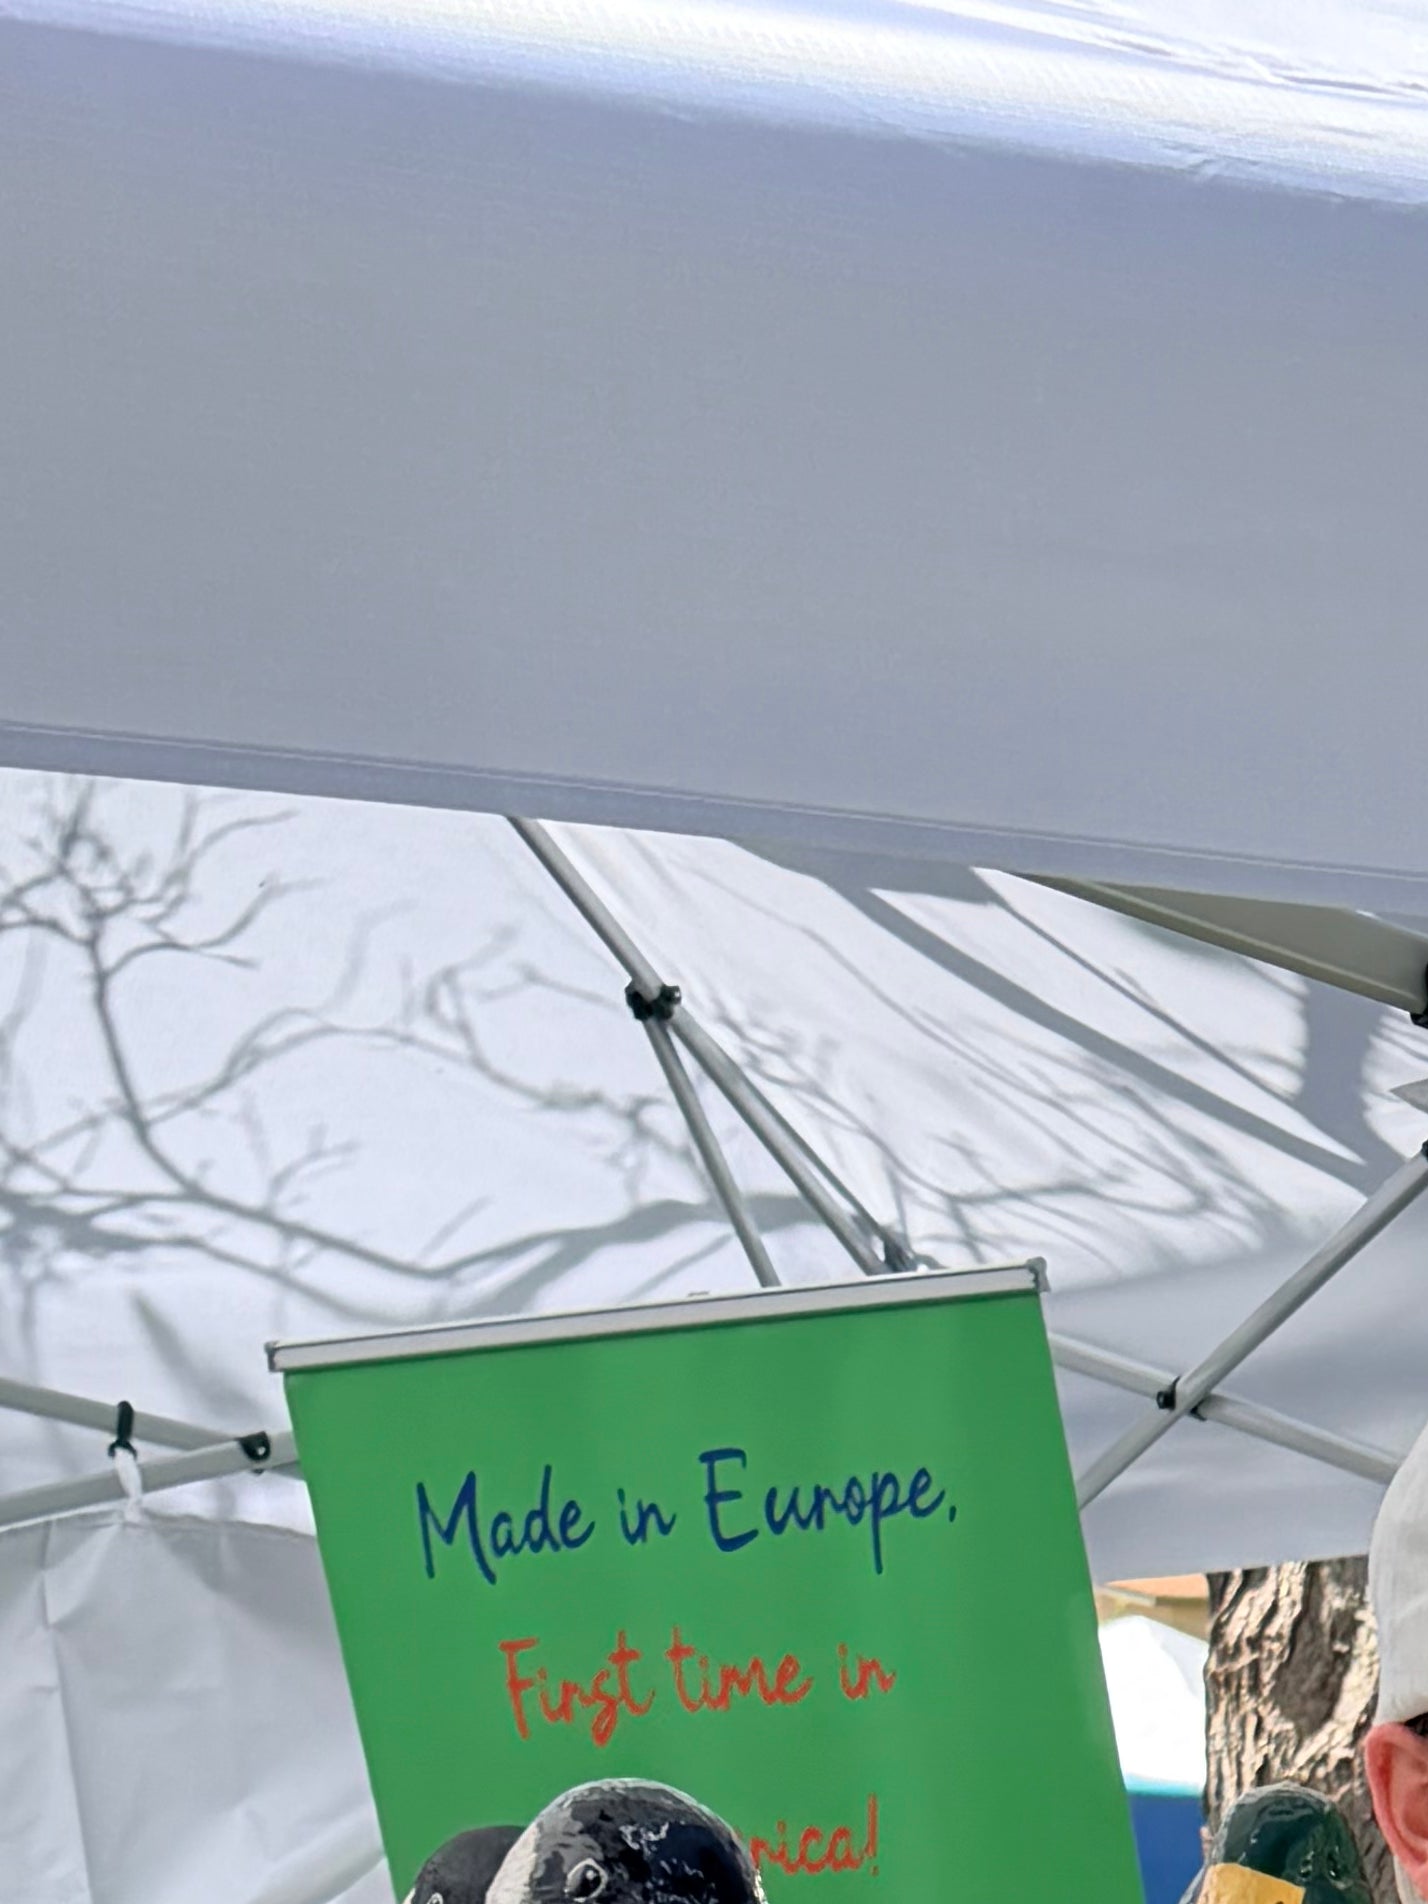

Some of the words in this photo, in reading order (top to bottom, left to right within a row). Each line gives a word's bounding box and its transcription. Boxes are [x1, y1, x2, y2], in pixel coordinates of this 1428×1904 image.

[416, 1464, 595, 1585] Made
[616, 1487, 676, 1545] in
[499, 1629, 655, 1749] First
[665, 1624, 813, 1713] time
[837, 1641, 896, 1701] in
